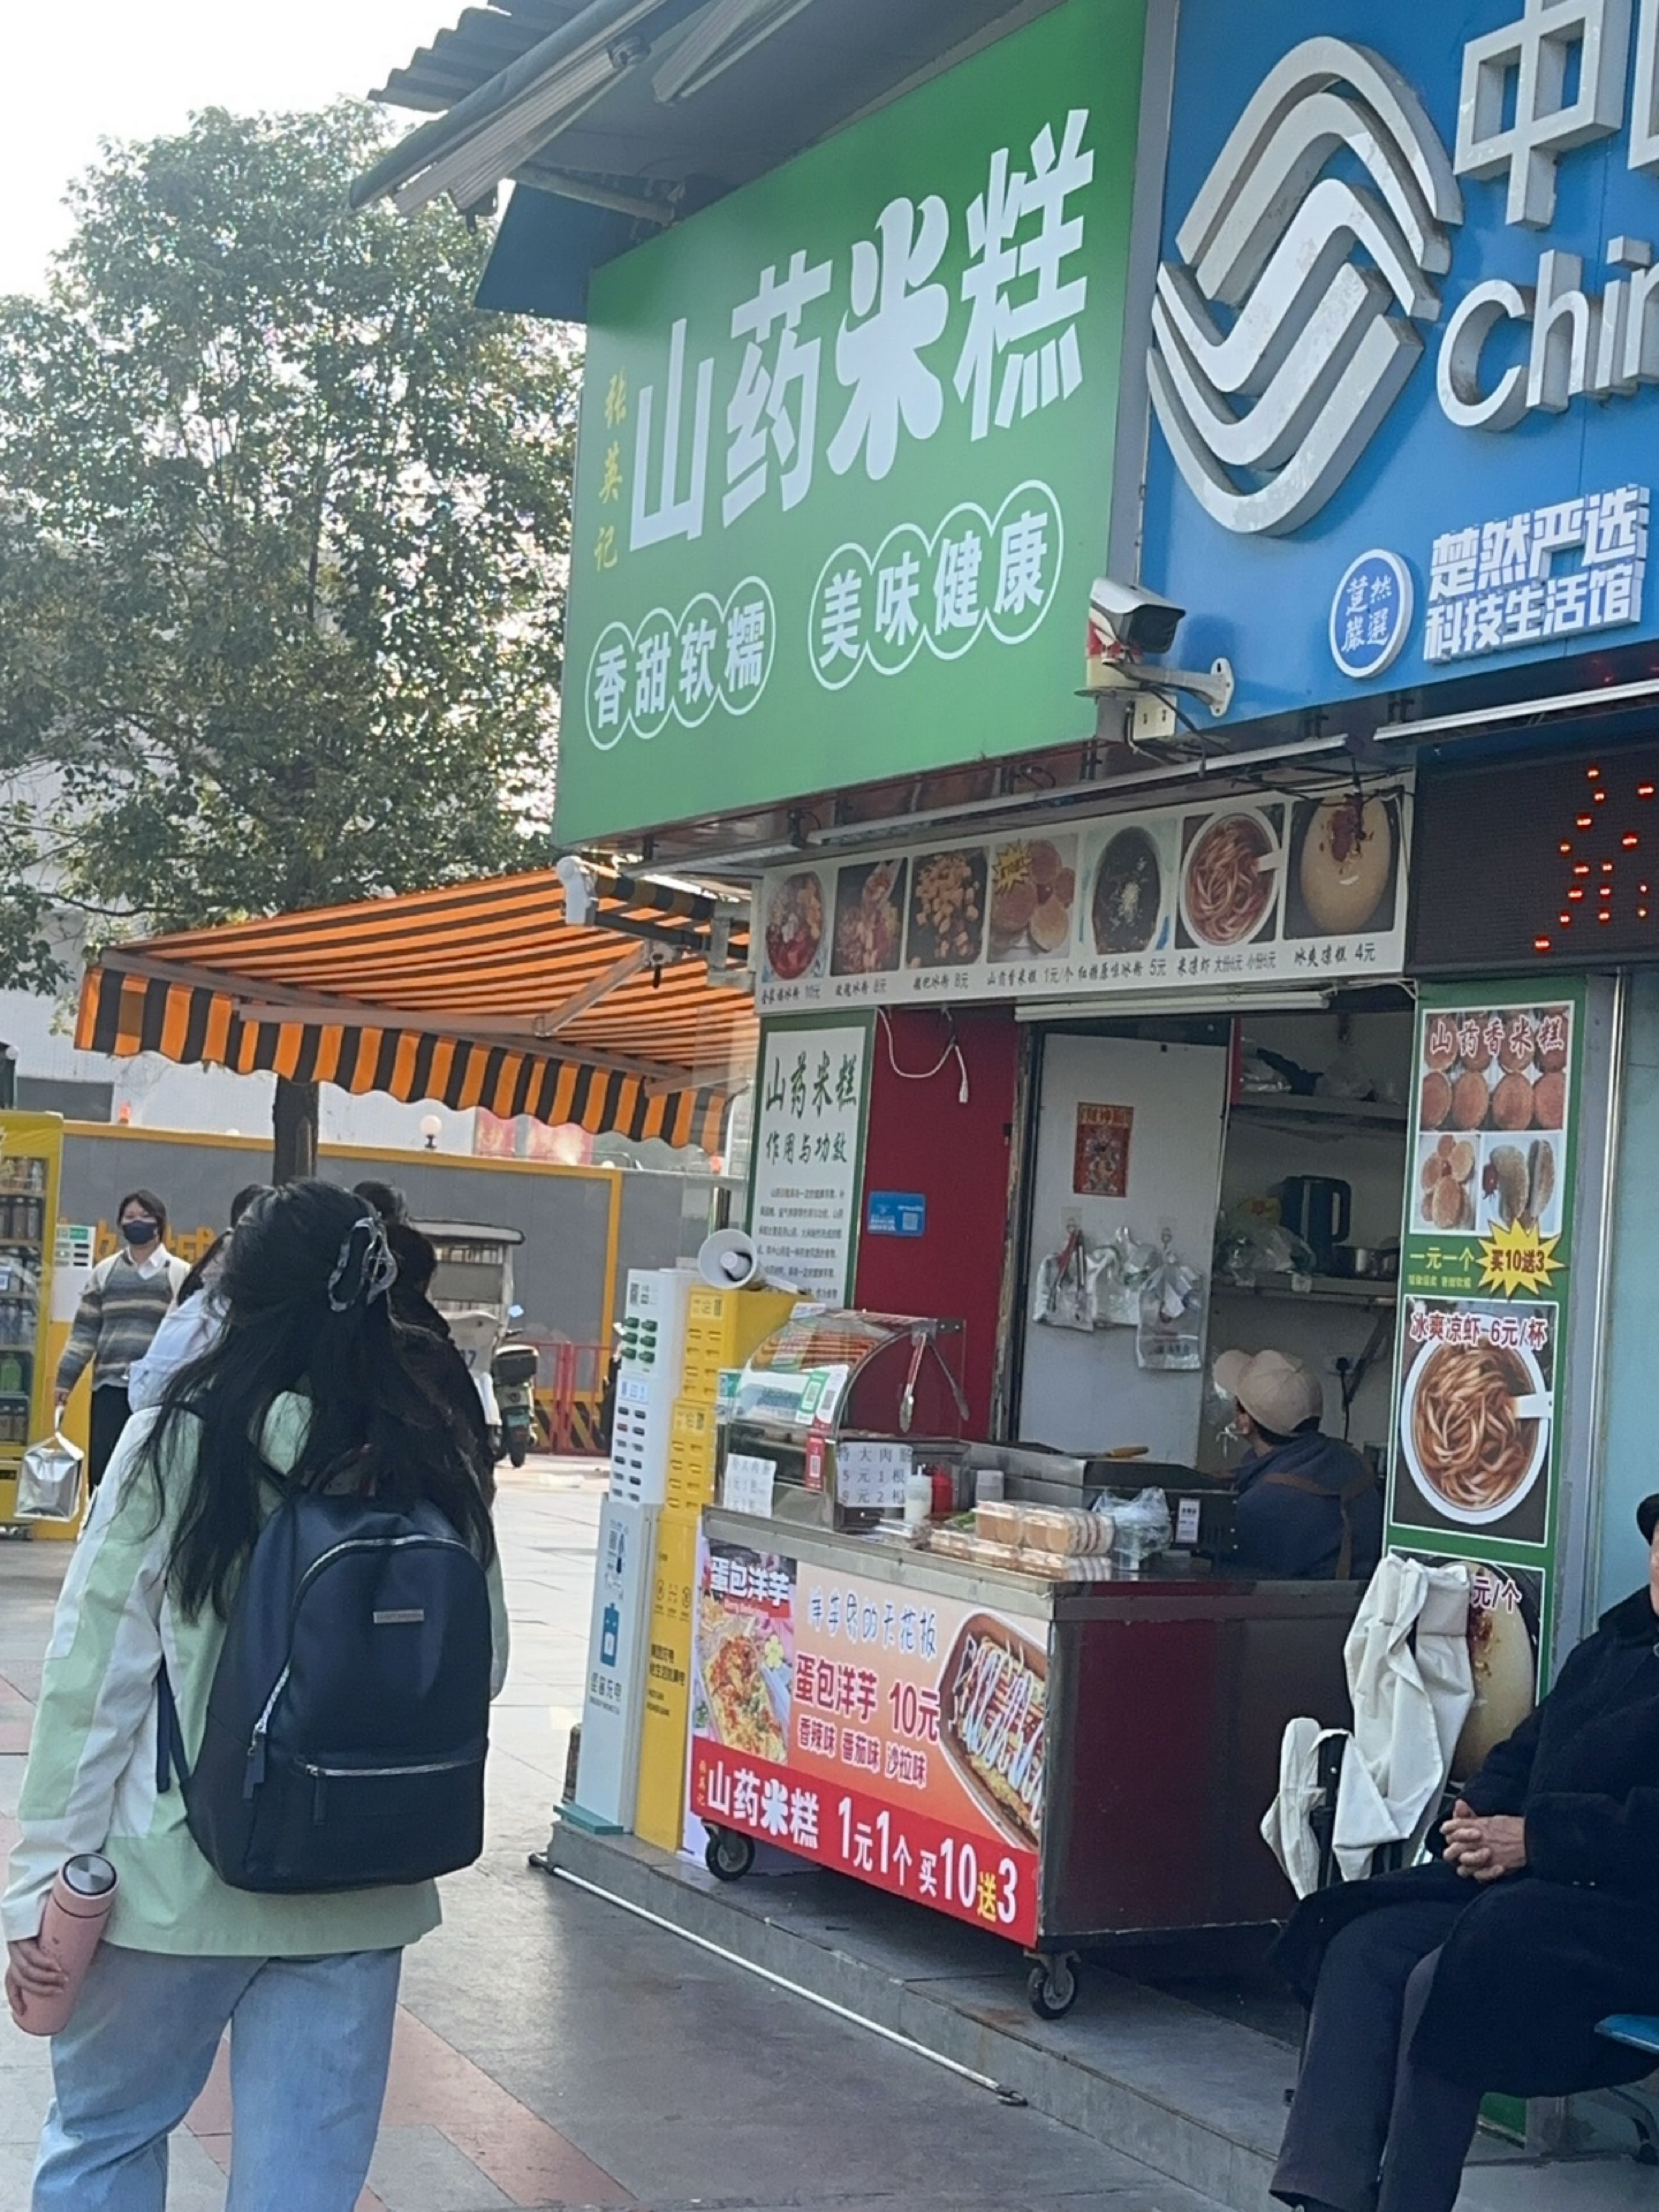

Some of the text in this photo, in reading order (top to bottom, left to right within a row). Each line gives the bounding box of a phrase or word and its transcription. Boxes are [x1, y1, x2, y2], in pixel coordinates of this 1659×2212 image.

[1453, 0, 1659, 229] 中
[630, 109, 1094, 552] 山药米糕
[819, 510, 1048, 669] 美味健康
[1429, 485, 1644, 600] 楚然严选
[1423, 563, 1640, 661] 科技生活馆
[594, 600, 765, 729] 香甜软糯
[1354, 942, 1376, 963] 4元
[1429, 1013, 1564, 1059] 山药香米糕
[1409, 1247, 1475, 1272] 一元一个
[1491, 1249, 1545, 1274] 买10送3
[709, 1557, 790, 1608] 蛋包洋芋
[794, 1653, 940, 1743] 蛋包洋芋 10元
[798, 1715, 927, 1788] 香辣味 番茄味 沙拉味
[707, 1760, 1019, 1924] 山药米糕 1元1个 买10送3
